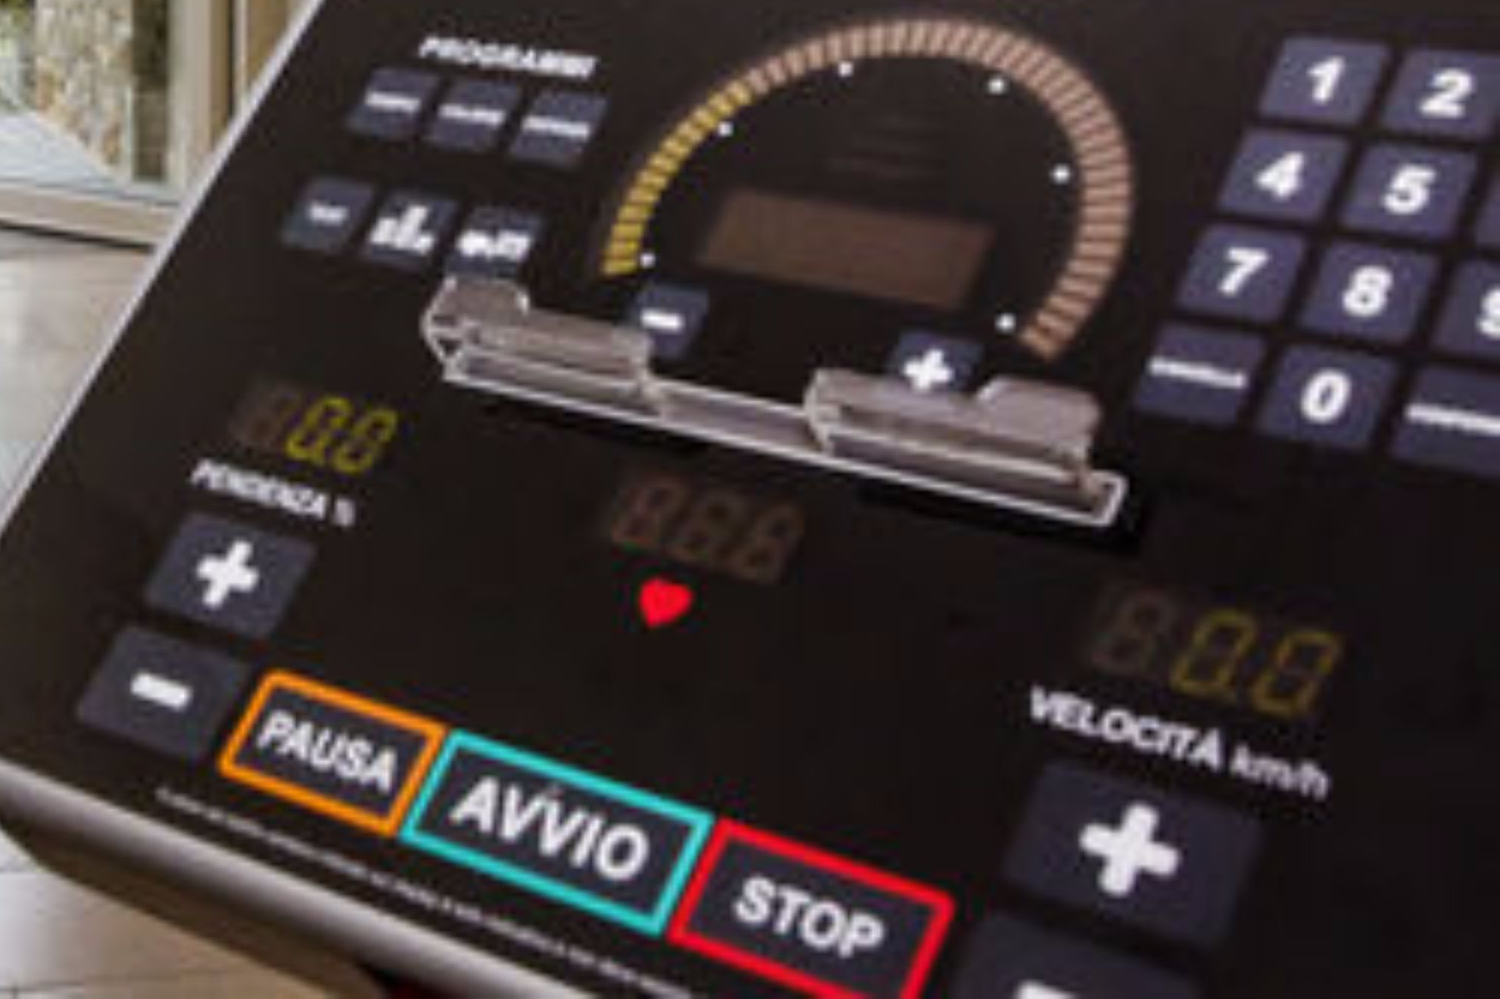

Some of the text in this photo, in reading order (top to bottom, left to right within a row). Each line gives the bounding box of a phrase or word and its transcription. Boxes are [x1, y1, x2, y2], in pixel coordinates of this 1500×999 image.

[1307, 55, 1346, 105] 1
[1419, 67, 1474, 119] 2
[1254, 150, 1305, 201] 4
[1381, 163, 1437, 216] 5
[1218, 245, 1270, 297] 7
[1342, 264, 1394, 319] 8
[1301, 370, 1351, 424] 0
[257, 710, 397, 793] PAUSA
[449, 776, 649, 881] AVVIO
[734, 876, 884, 958] STOP
